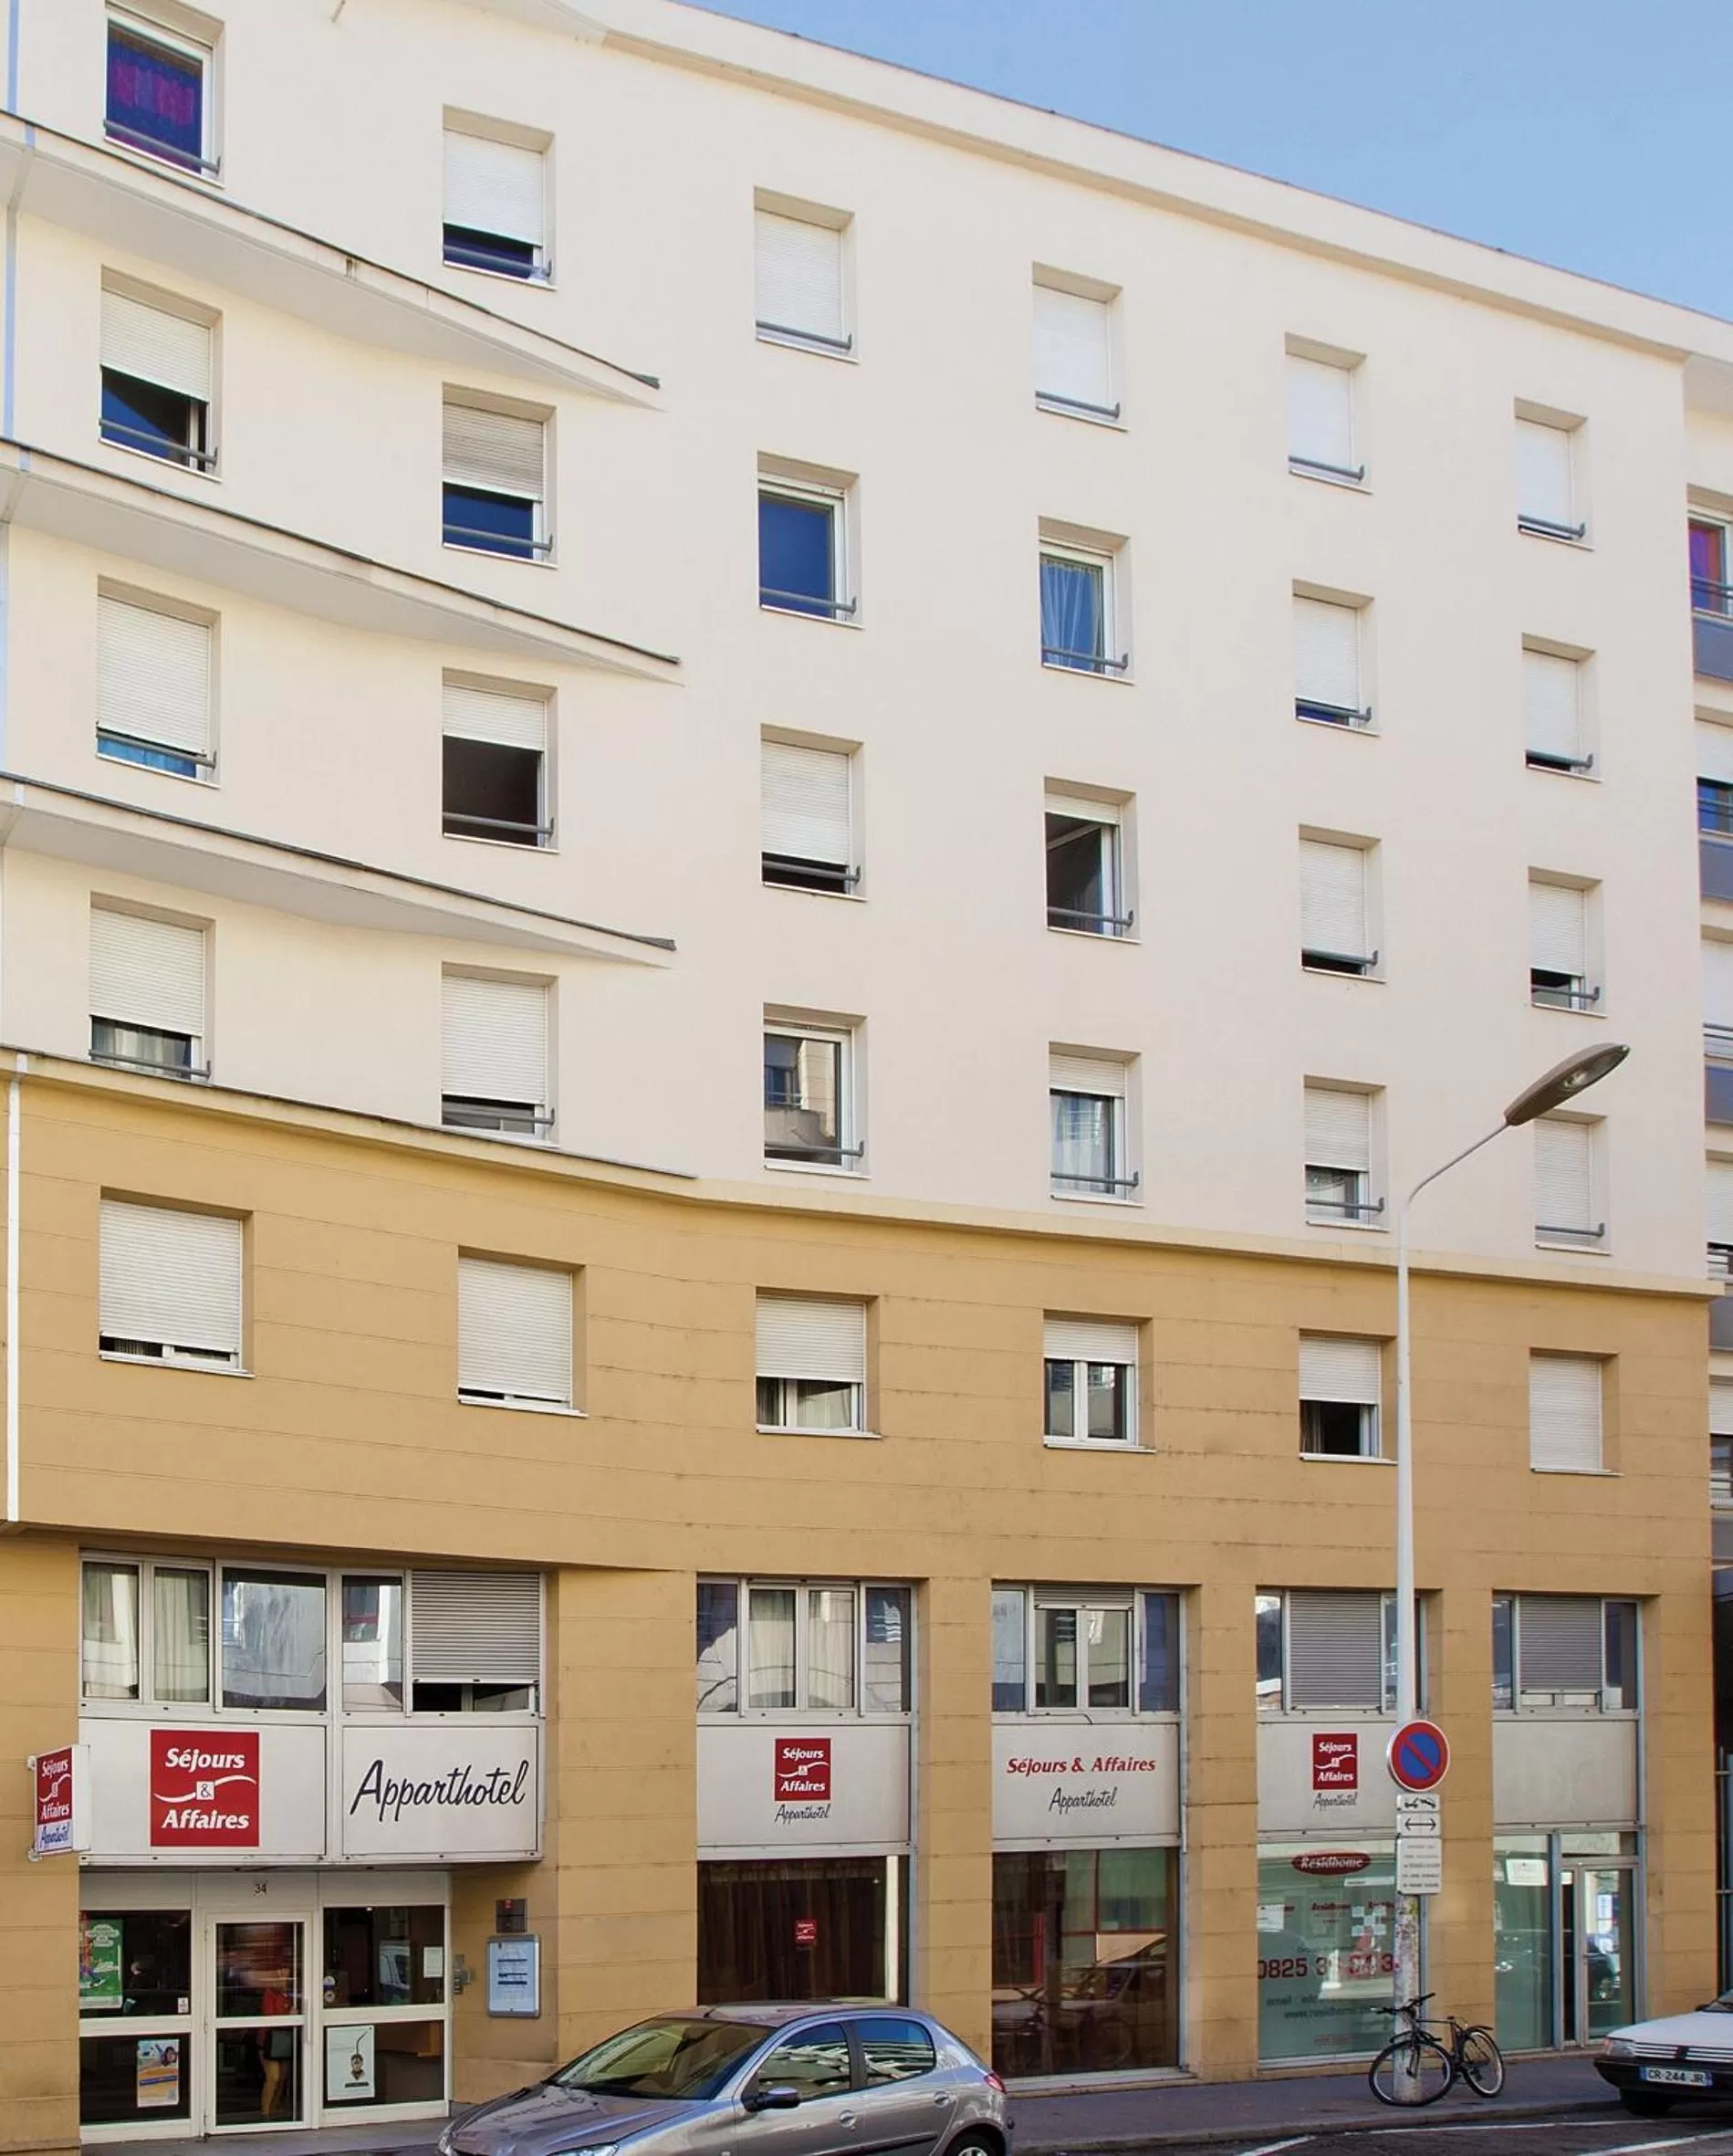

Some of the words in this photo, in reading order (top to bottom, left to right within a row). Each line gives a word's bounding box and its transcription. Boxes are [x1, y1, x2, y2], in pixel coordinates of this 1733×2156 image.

[164, 1747, 245, 1773] Séjours
[781, 1747, 825, 1761] Séjours
[1007, 1758, 1067, 1777] Séjours
[1071, 1757, 1085, 1773] &
[1091, 1756, 1156, 1773] Affaires
[200, 1783, 213, 1798] &
[350, 1759, 529, 1822] Apparthotel
[780, 1781, 826, 1792] Affaires
[1049, 1786, 1118, 1815] Apparthotel
[161, 1808, 249, 1829] Affaires
[256, 1883, 266, 1895] 34
[1258, 1957, 1308, 1979] 0825
